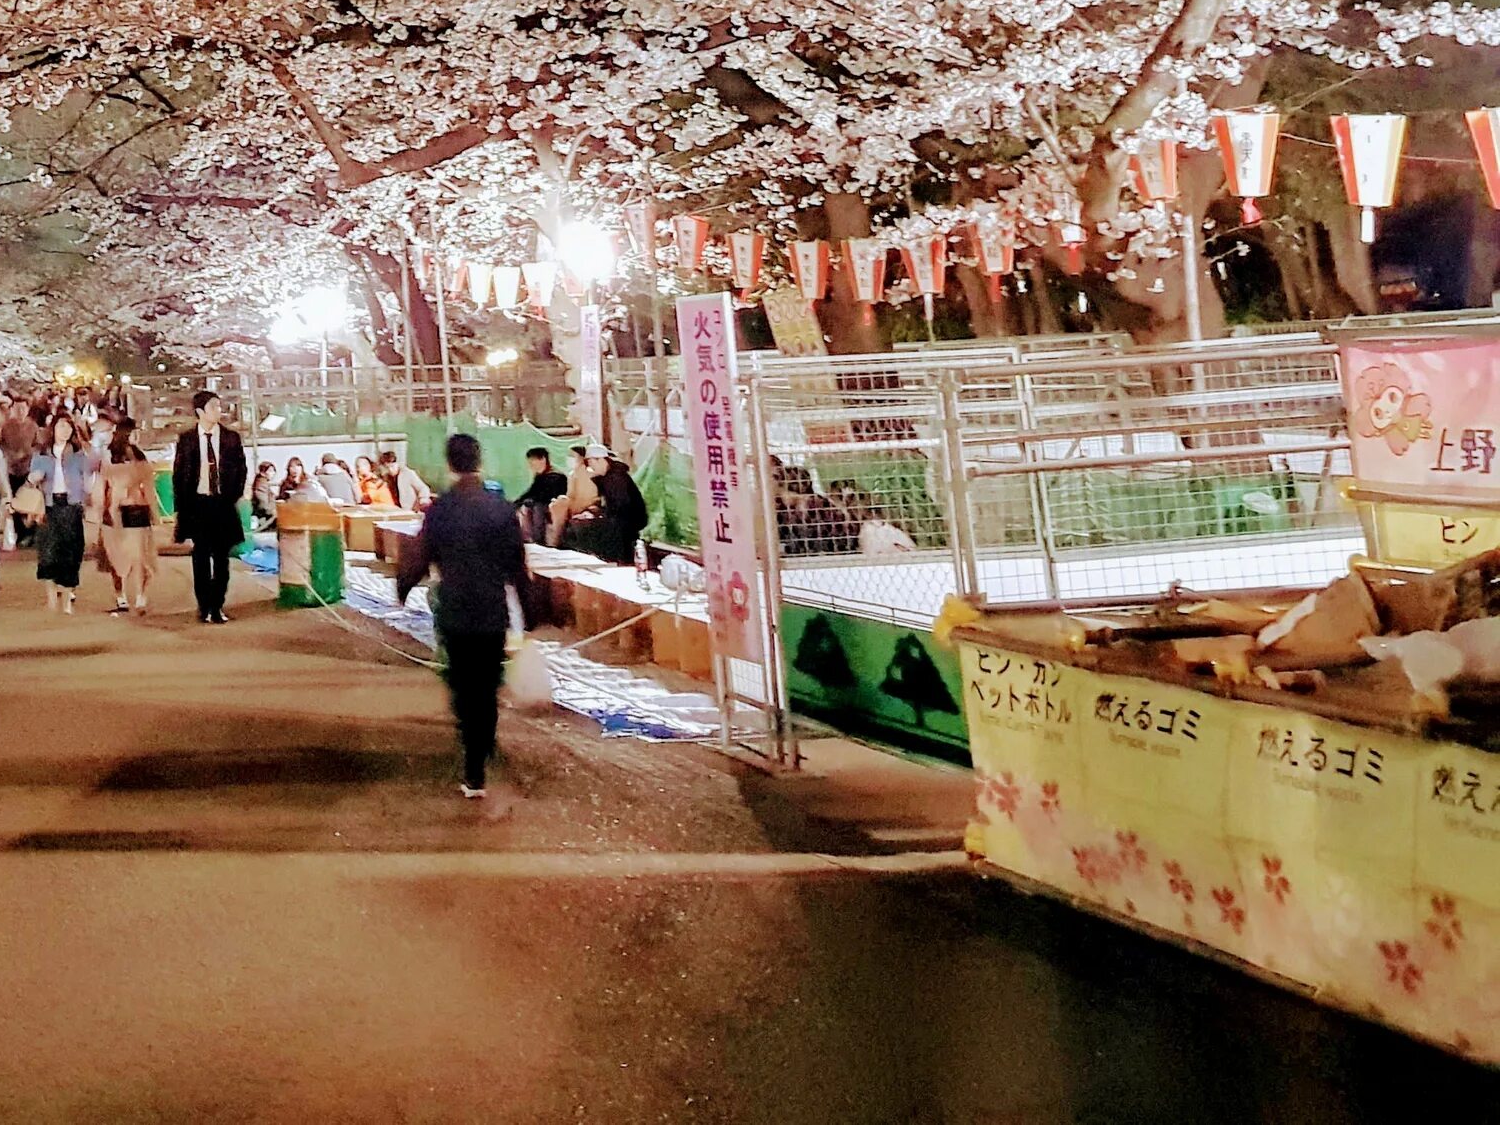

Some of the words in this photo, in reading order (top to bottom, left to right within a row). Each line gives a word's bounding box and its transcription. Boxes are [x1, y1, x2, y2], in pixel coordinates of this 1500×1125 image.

[693, 310, 733, 544] 火気の使用禁止
[1429, 426, 1497, 474] 上野
[1430, 764, 1500, 814] 燃え
